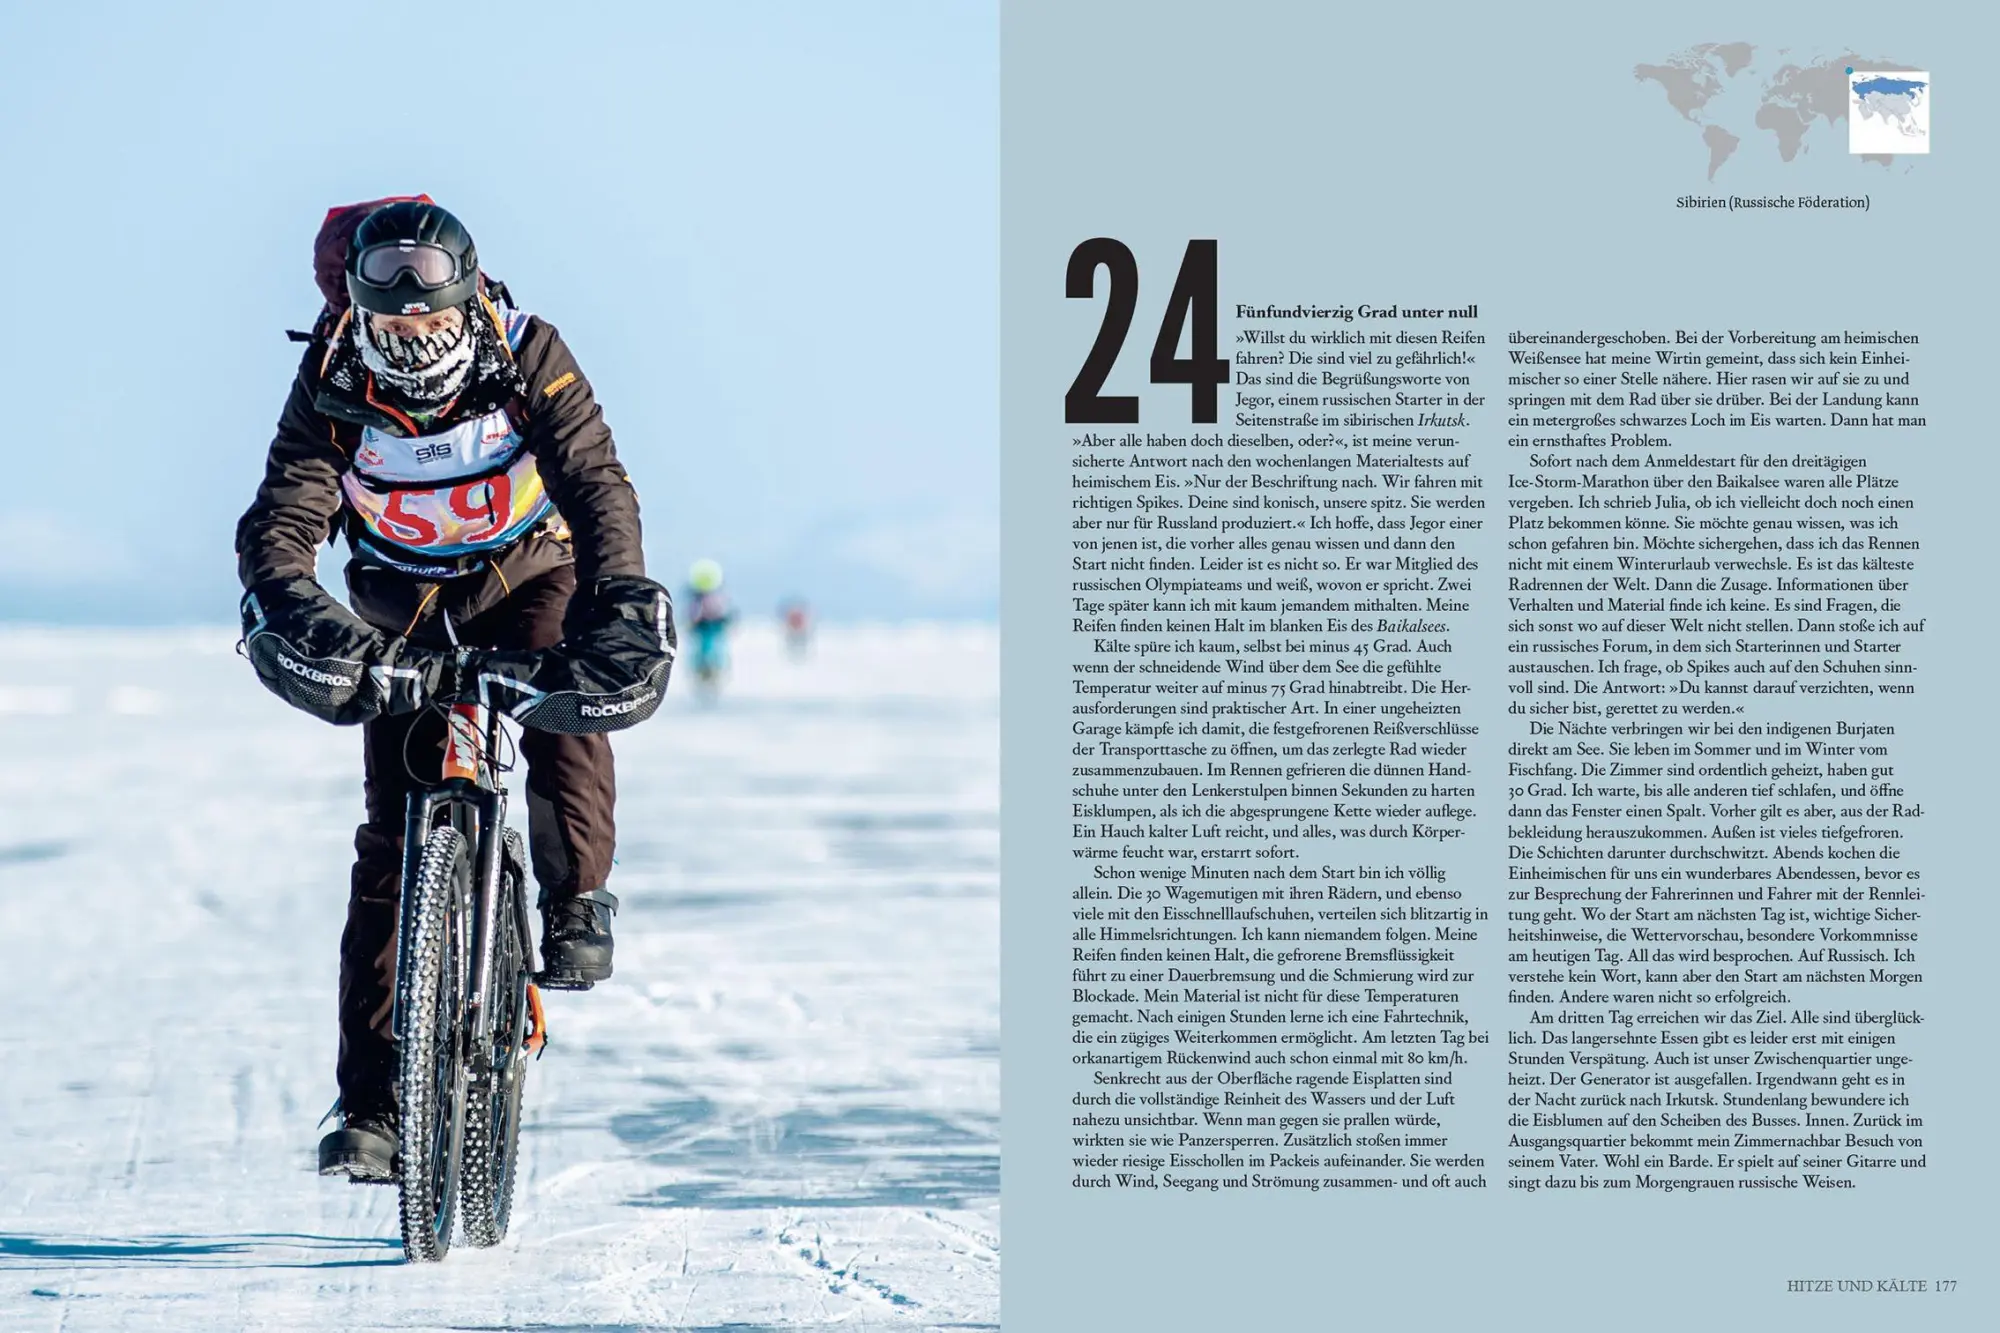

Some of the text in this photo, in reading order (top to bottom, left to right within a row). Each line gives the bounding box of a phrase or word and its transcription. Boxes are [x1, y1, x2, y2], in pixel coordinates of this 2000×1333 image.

[1676, 195, 1870, 211] Sibirien (Russische Föderation)
[1236, 305, 1478, 322] Fünfundvierzig Grad unter null
[1065, 237, 1230, 424] 24
[1236, 330, 1485, 344] »Willst du wirklich mit diesen Reifen
[1508, 330, 1919, 348] übereinandergeschoben. Bei der Vorbereitung am heimischen
[1236, 413, 1470, 427] Seitenstraße im sibirischen Irkutsk.
[1073, 433, 1459, 449] »Aber alle haben doch dieselben, oder?«, ist meine verun-
[1530, 454, 1866, 472] Sofort nach dem Anmeldestart für den dreitägigen
[377, 474, 512, 546] 59
[1073, 515, 1483, 533] aber nur für Russland produziert.« Ich hoffe, dass Jegor einer
[1508, 639, 1901, 655] ein russisches Forum, in dem sich Starterinnen und Starter
[276, 653, 352, 686] ROCKBROS
[581, 691, 658, 717] ROCKBROS
[1073, 701, 1461, 718] ausforderungen sind praktischer Art. In einer ungeheizten
[1072, 783, 1475, 801] schuhe unter den Lenkerstulpen binnen Sekunden zu harten
[1509, 783, 1903, 800] 30 Grad. Ich warte, bis alle anderen tief schlafen, und öffne
[1508, 845, 1900, 859] Die Schichten darunter durchschwitzt. Abends kochen die
[1072, 886, 1462, 904] allein. Die 30 Wagemutigen mit ihren Rädern, und ebenso
[1508, 969, 1922, 987] verstehe kein Wort, kann aber den Start am nächsten Morgen
[1073, 1050, 1467, 1068] orkanartigem Rückenwind auch schon einmal mit 80 km/h.
[1508, 1072, 1905, 1090] heizt. Der Generator ist ausgefallen. Irgendwann geht es in
[1072, 1174, 1487, 1192] durch Wind, Seegang und Strömung zusammen- und oft auch
[1508, 1175, 1855, 1192] singt dazu bis zum Morgengrauen russische Weisen.
[1787, 1279, 1957, 1292] HITZE UND KÄLTE 177
